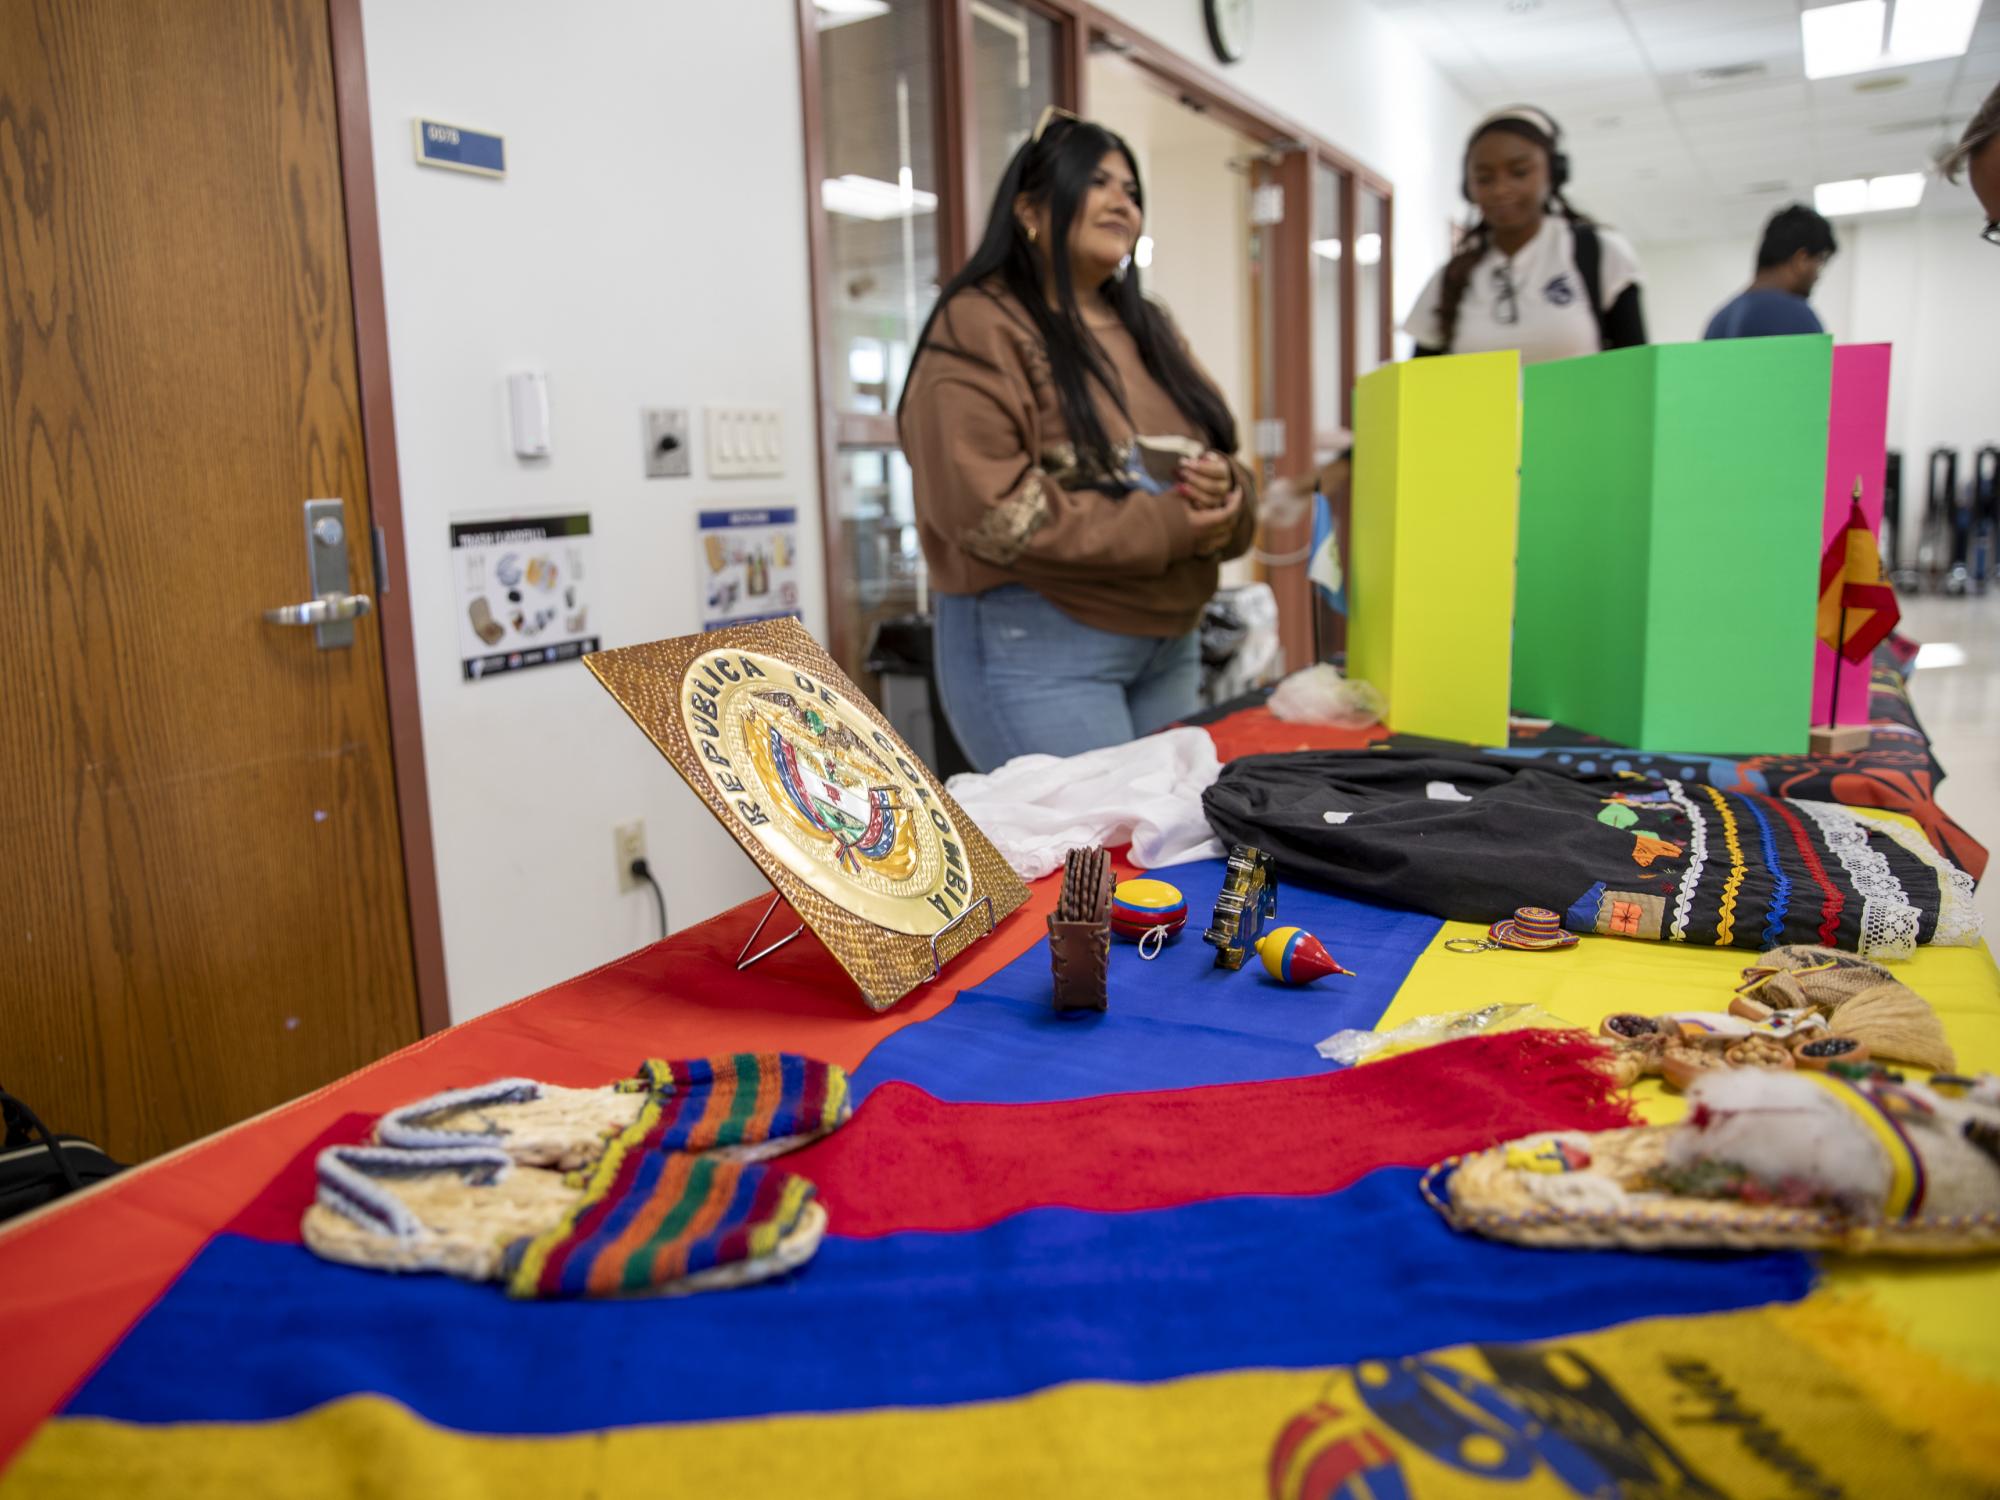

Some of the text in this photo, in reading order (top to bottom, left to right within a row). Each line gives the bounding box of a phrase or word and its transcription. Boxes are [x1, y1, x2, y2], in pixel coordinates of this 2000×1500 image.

[691, 656, 968, 921] REPUBLICA DE COLOMBIA
